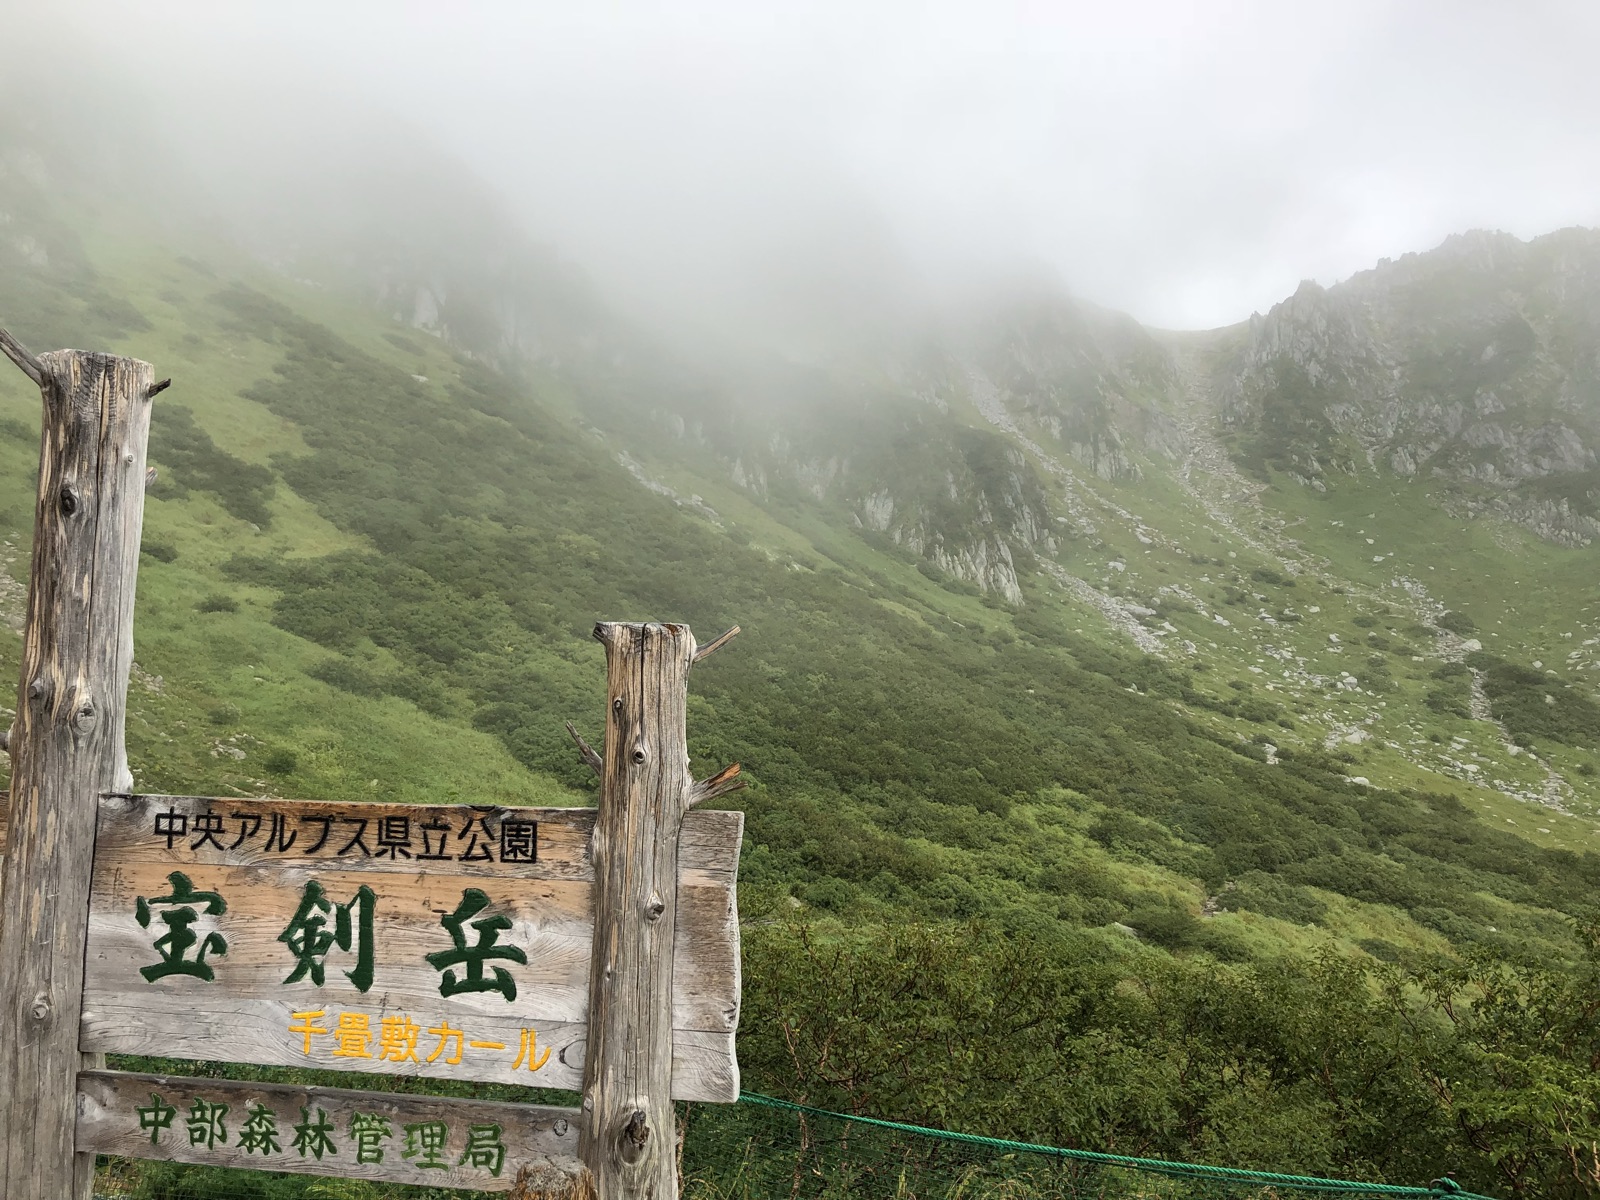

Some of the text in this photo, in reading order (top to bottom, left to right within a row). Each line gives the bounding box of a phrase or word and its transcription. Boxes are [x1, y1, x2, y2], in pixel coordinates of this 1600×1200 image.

[154, 806, 538, 864] 中央アルプス県立公園
[135, 871, 529, 1002] 宝剣岳
[288, 1010, 552, 1072] 千畳敷カール
[136, 1092, 507, 1178] 中部森林管理局
